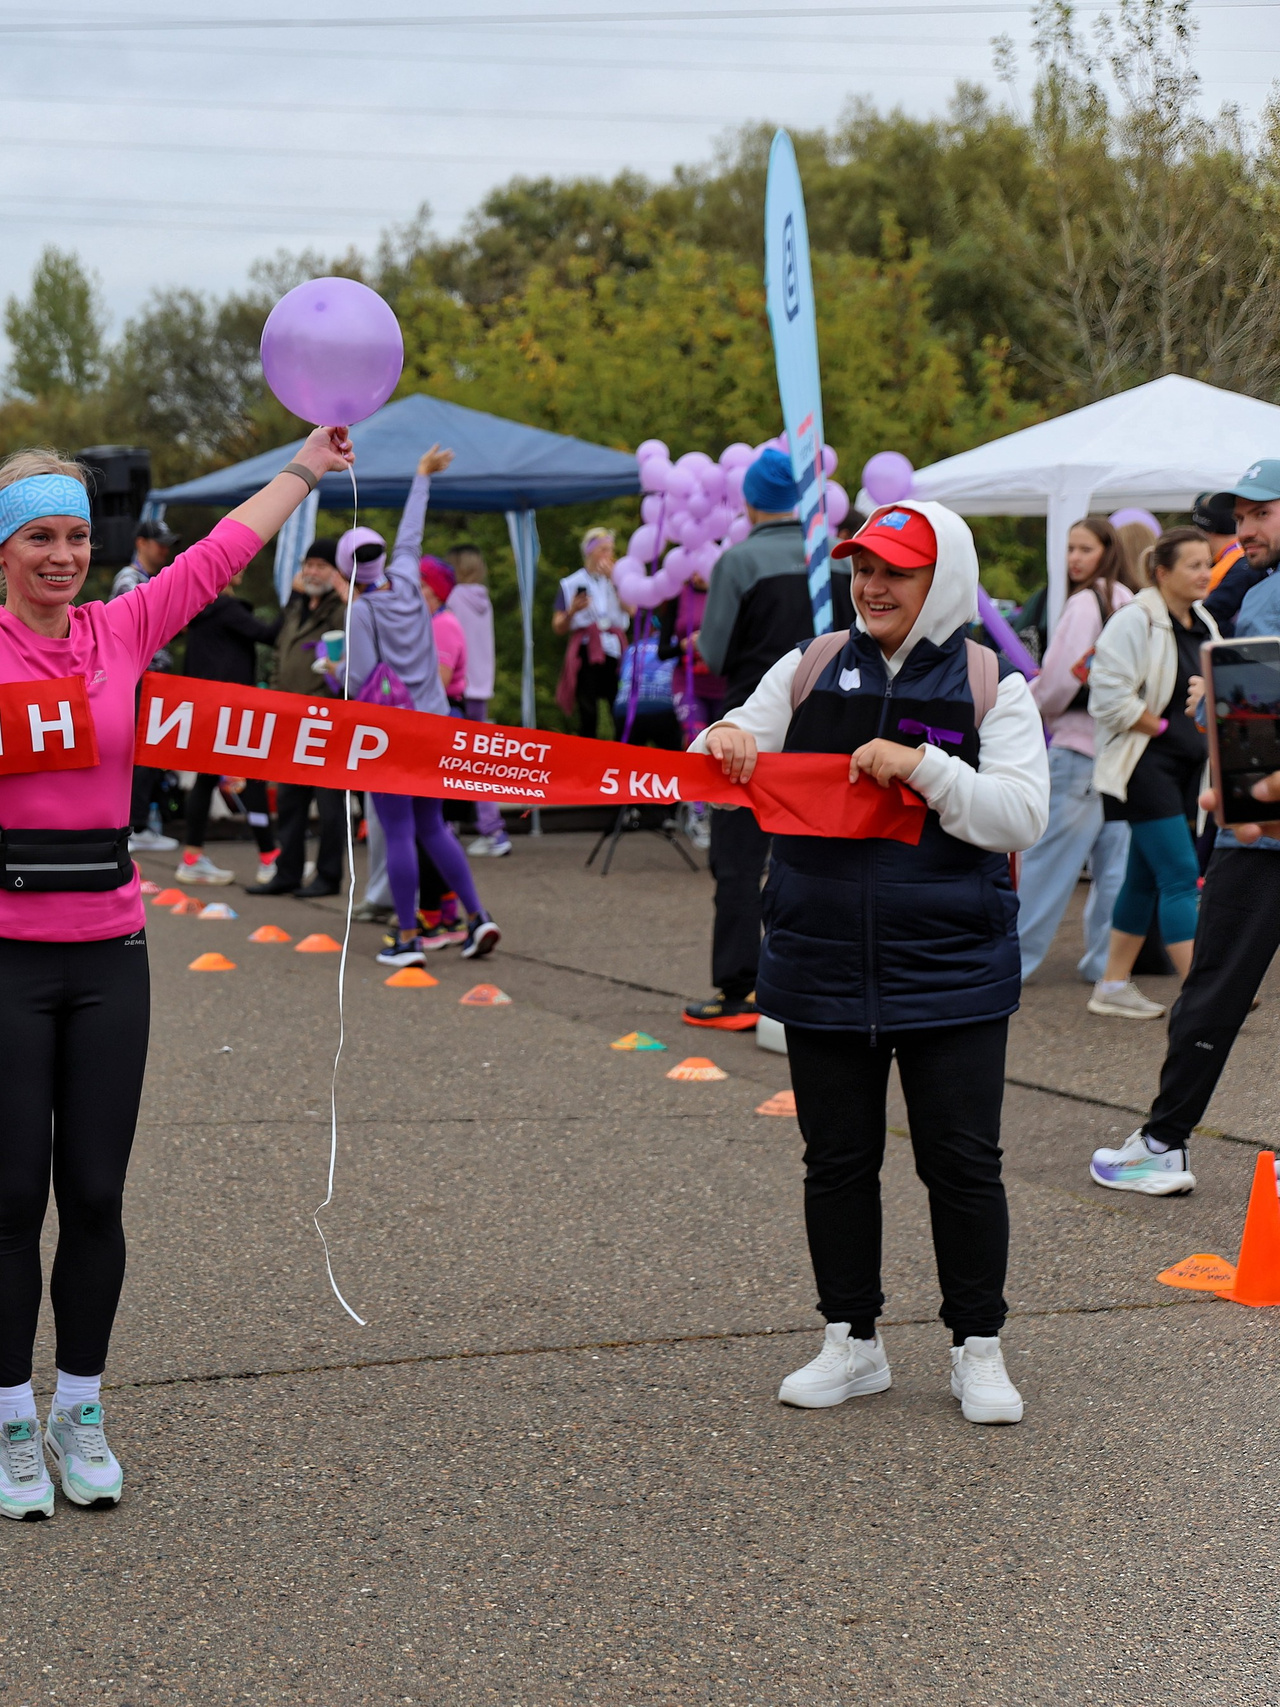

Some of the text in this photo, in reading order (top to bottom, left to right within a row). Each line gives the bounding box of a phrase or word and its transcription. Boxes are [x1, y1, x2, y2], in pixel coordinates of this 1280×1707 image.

[146, 697, 390, 771] ИШЁР
[453, 731, 551, 764] 5 ВЁРСТ
[438, 755, 551, 784] КРАСНОЯРСК
[600, 769, 681, 800] 5 КМ
[443, 776, 546, 799] НАБЕРЕЖНАЯ
